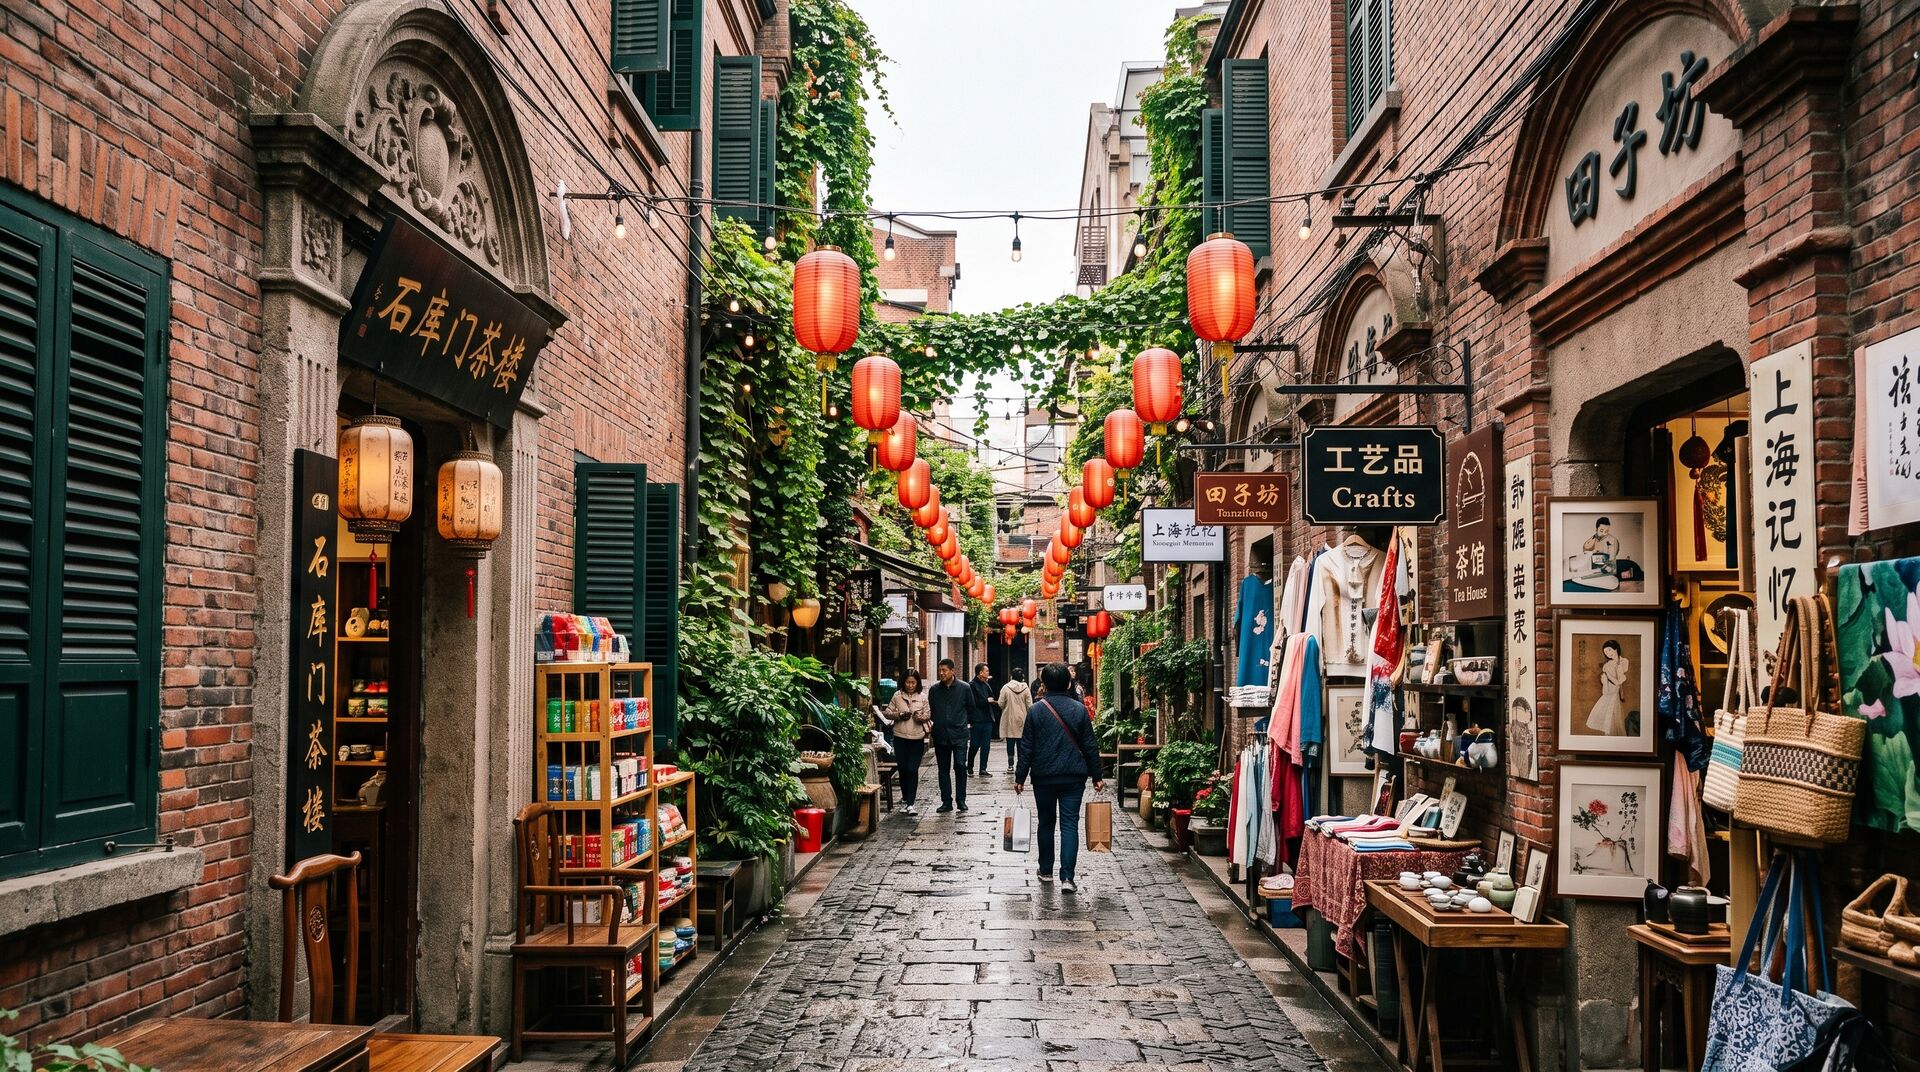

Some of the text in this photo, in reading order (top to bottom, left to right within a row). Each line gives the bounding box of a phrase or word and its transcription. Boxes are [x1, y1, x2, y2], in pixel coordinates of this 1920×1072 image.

[1565, 50, 1709, 229] 田子坊
[378, 276, 525, 394] 石库门茶楼
[1323, 444, 1424, 475] 工艺品
[1205, 483, 1279, 506] 田子坊
[1332, 486, 1416, 508] Crafts
[1764, 369, 1801, 620] 上海记忆
[1152, 522, 1217, 538] 上海记忆
[1455, 540, 1486, 581] 茶馆
[1453, 586, 1488, 603] Tea House
[303, 535, 329, 834] 石库门茶楼
